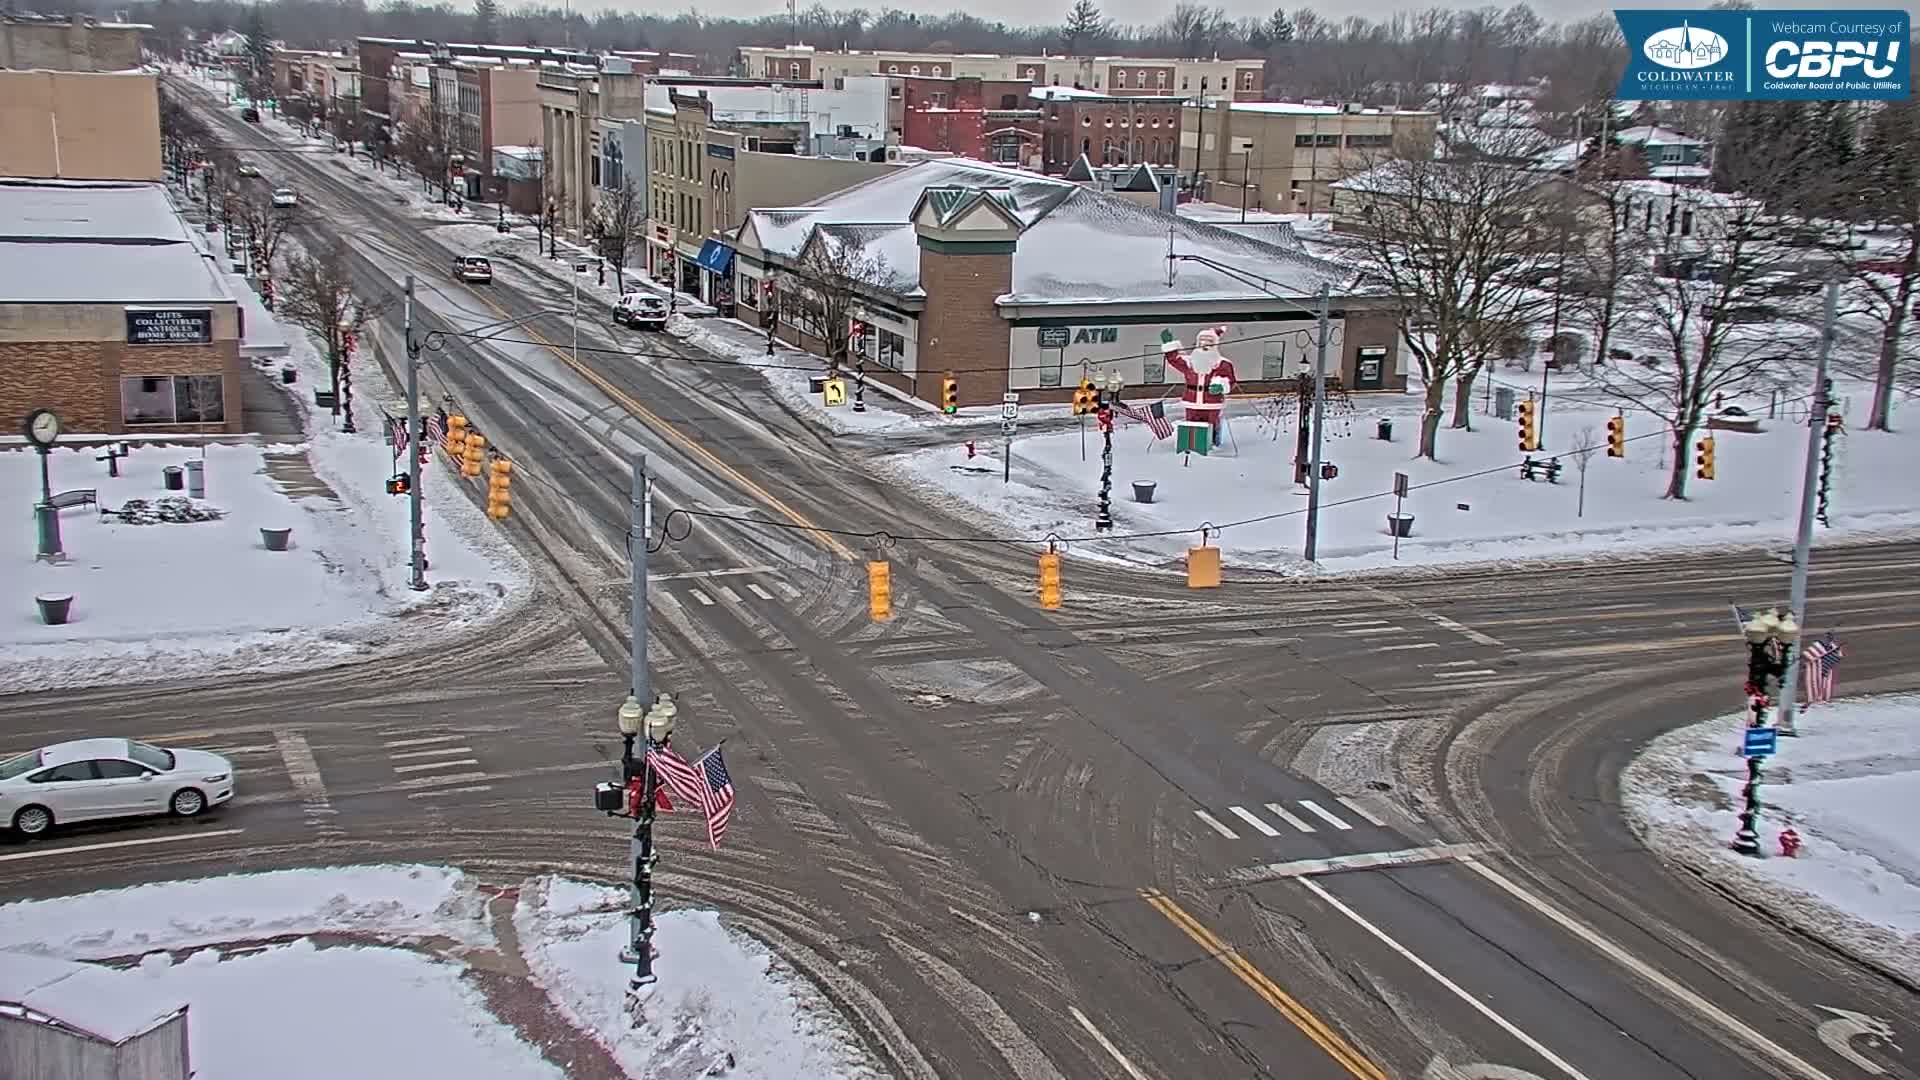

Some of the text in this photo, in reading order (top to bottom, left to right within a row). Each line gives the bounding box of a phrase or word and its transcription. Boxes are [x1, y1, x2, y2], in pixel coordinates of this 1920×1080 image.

[137, 331, 166, 339] HOME
[1073, 327, 1118, 344] ATM
[1005, 405, 1015, 415] 12
